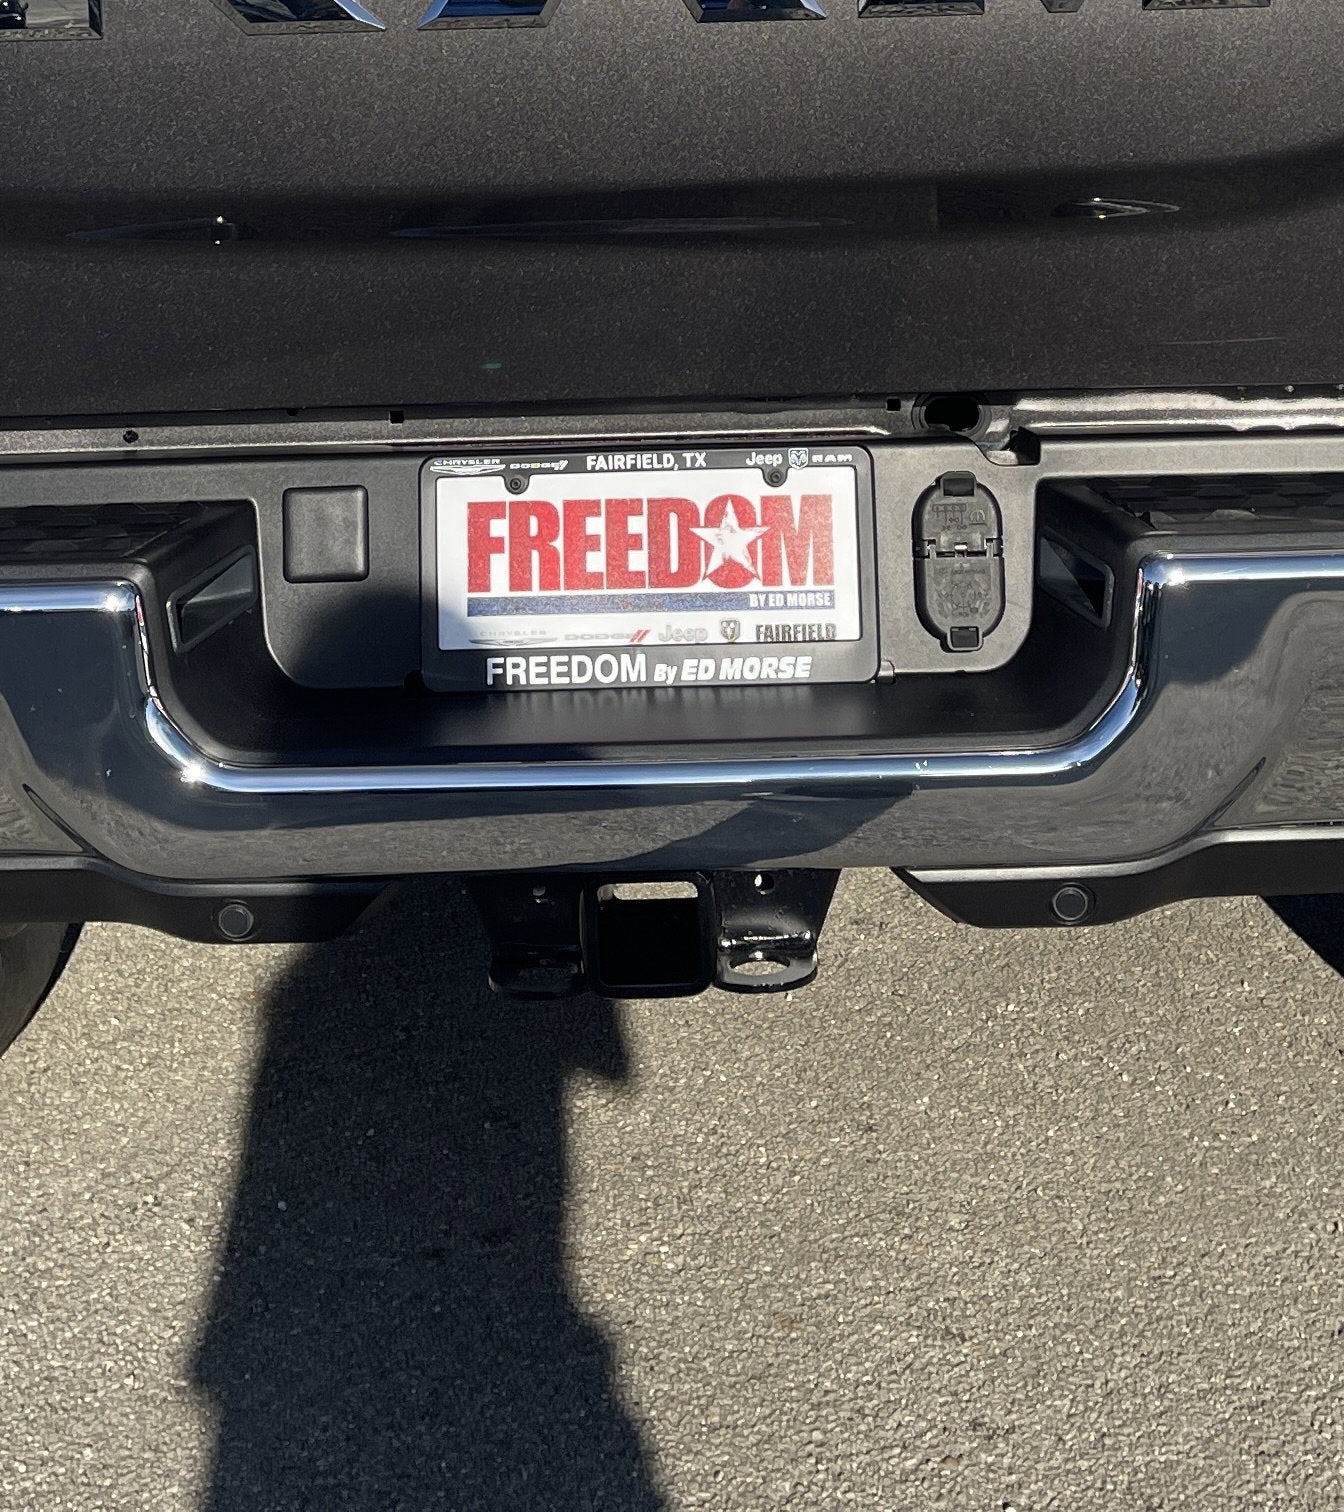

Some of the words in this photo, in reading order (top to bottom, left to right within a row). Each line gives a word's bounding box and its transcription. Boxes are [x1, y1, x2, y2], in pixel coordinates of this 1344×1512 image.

[682, 452, 707, 468] TX
[745, 452, 783, 468] Jeep
[467, 494, 834, 592] FREEDOM
[749, 593, 766, 607] BY
[768, 593, 784, 607] ED
[786, 592, 831, 607] MORSE
[657, 624, 708, 643] Jeep
[755, 623, 837, 642] FAIRFIELD
[486, 653, 647, 686] FREEDOM
[680, 657, 716, 681] ED
[718, 655, 813, 680] MORSE
